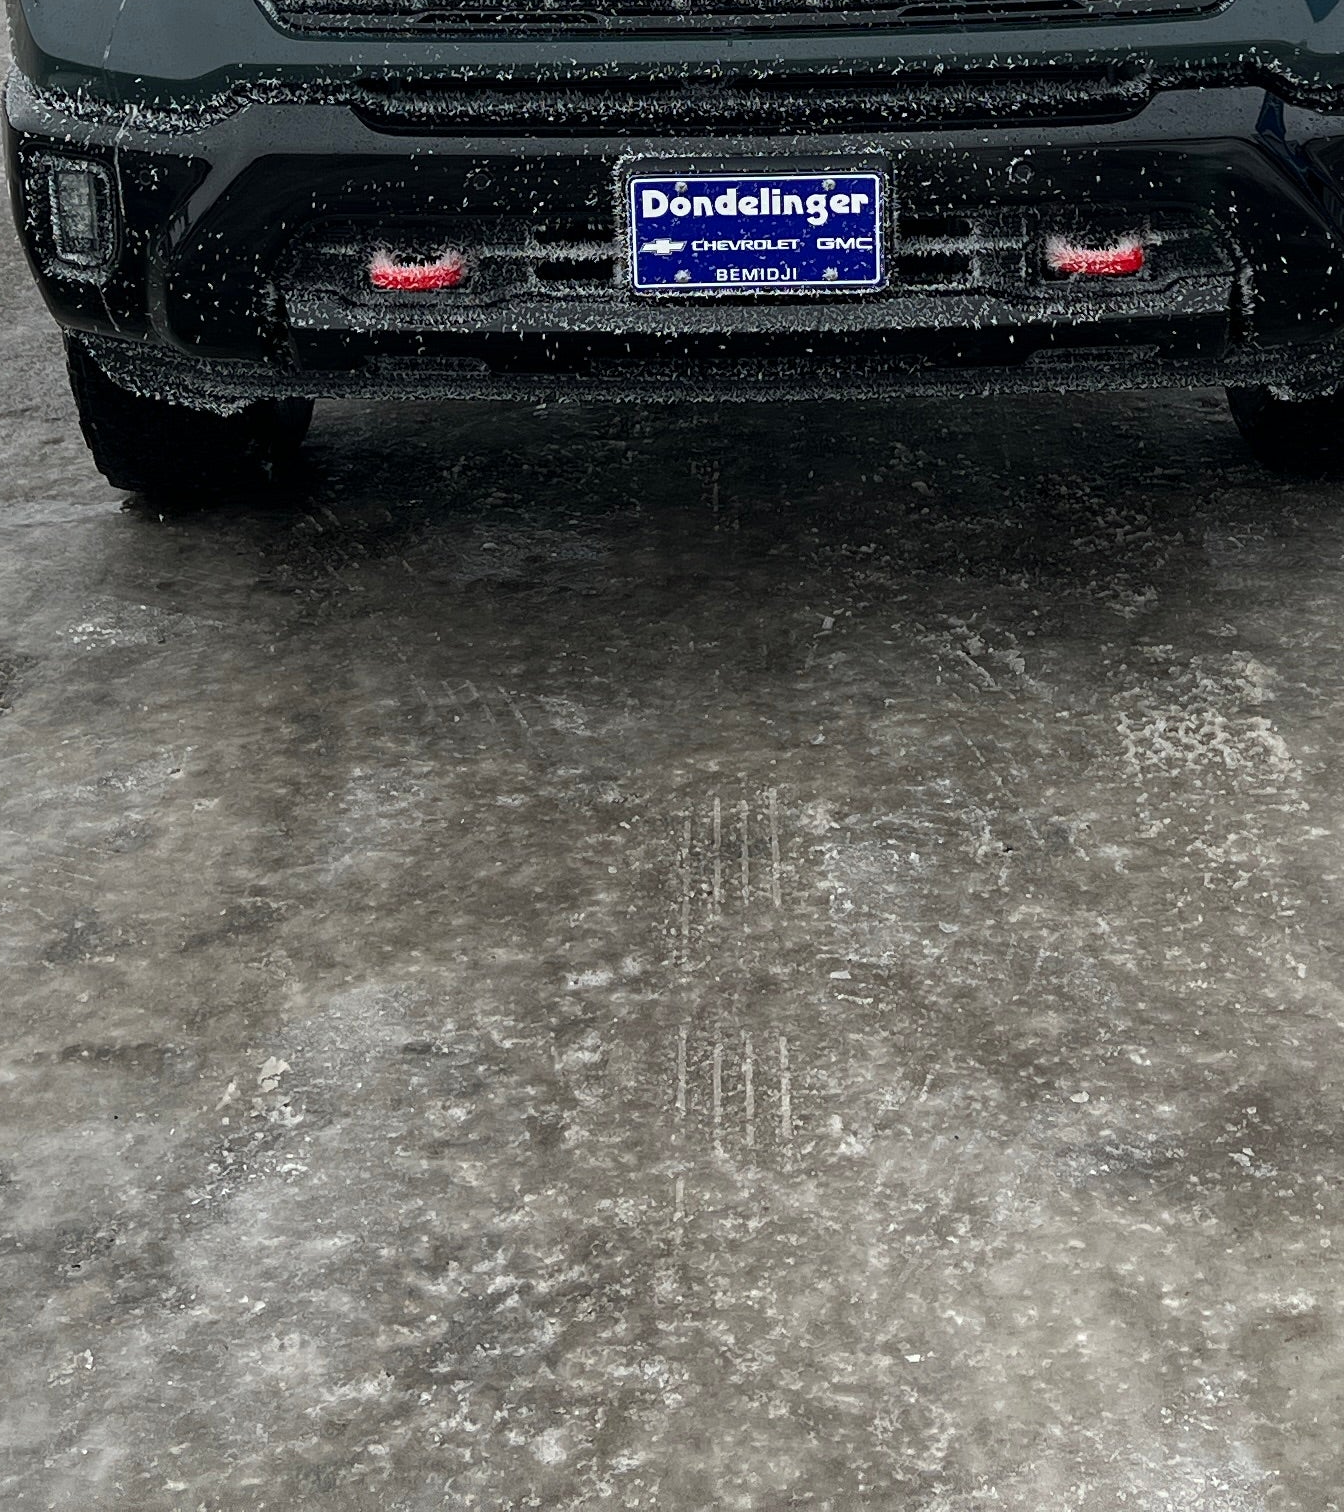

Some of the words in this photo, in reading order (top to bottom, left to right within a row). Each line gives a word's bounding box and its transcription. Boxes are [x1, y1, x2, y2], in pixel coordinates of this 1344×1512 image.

[641, 189, 869, 226] Dondelinger
[691, 238, 799, 251] CHEVROLET
[816, 237, 873, 250] GMC
[716, 267, 798, 281] BEMIDJI
